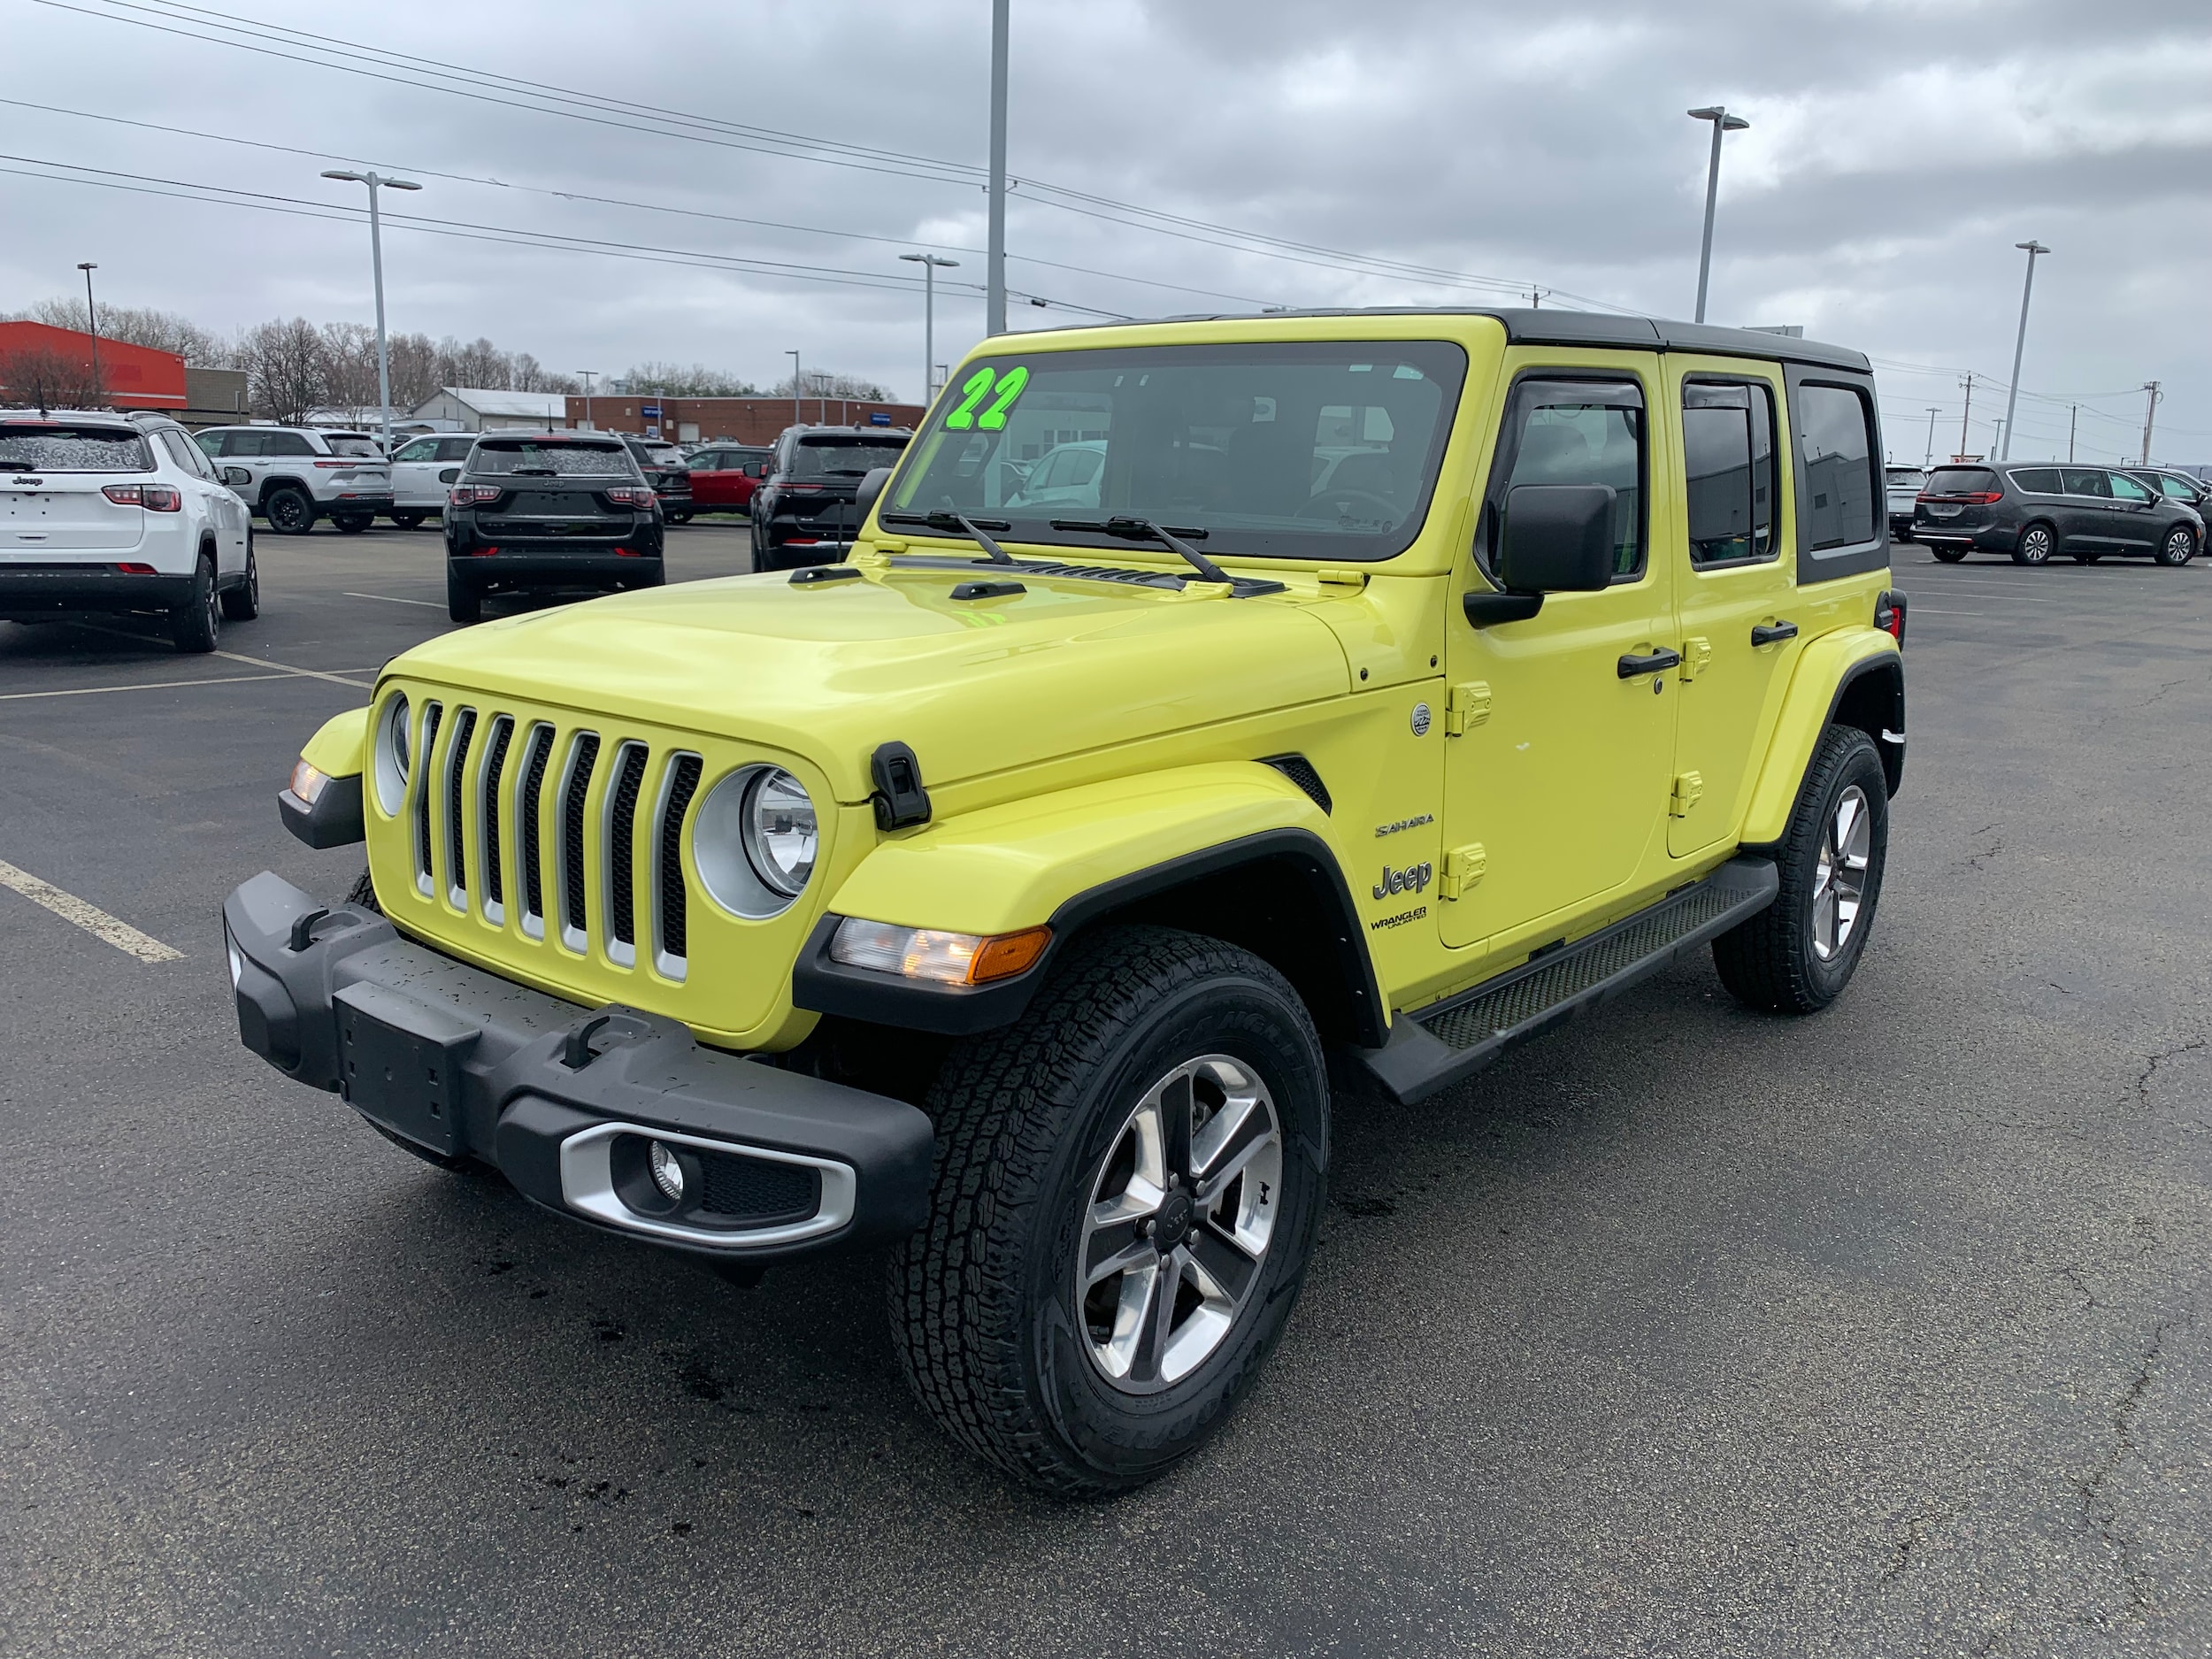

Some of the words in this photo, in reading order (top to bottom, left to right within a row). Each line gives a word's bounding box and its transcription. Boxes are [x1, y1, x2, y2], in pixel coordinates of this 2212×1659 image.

[946, 366, 1029, 431] 22
[12, 476, 42, 486] Jeep
[1375, 813, 1433, 837] SAHARA
[1372, 861, 1432, 900] Jeep
[1371, 906, 1427, 931] WRANGLER
